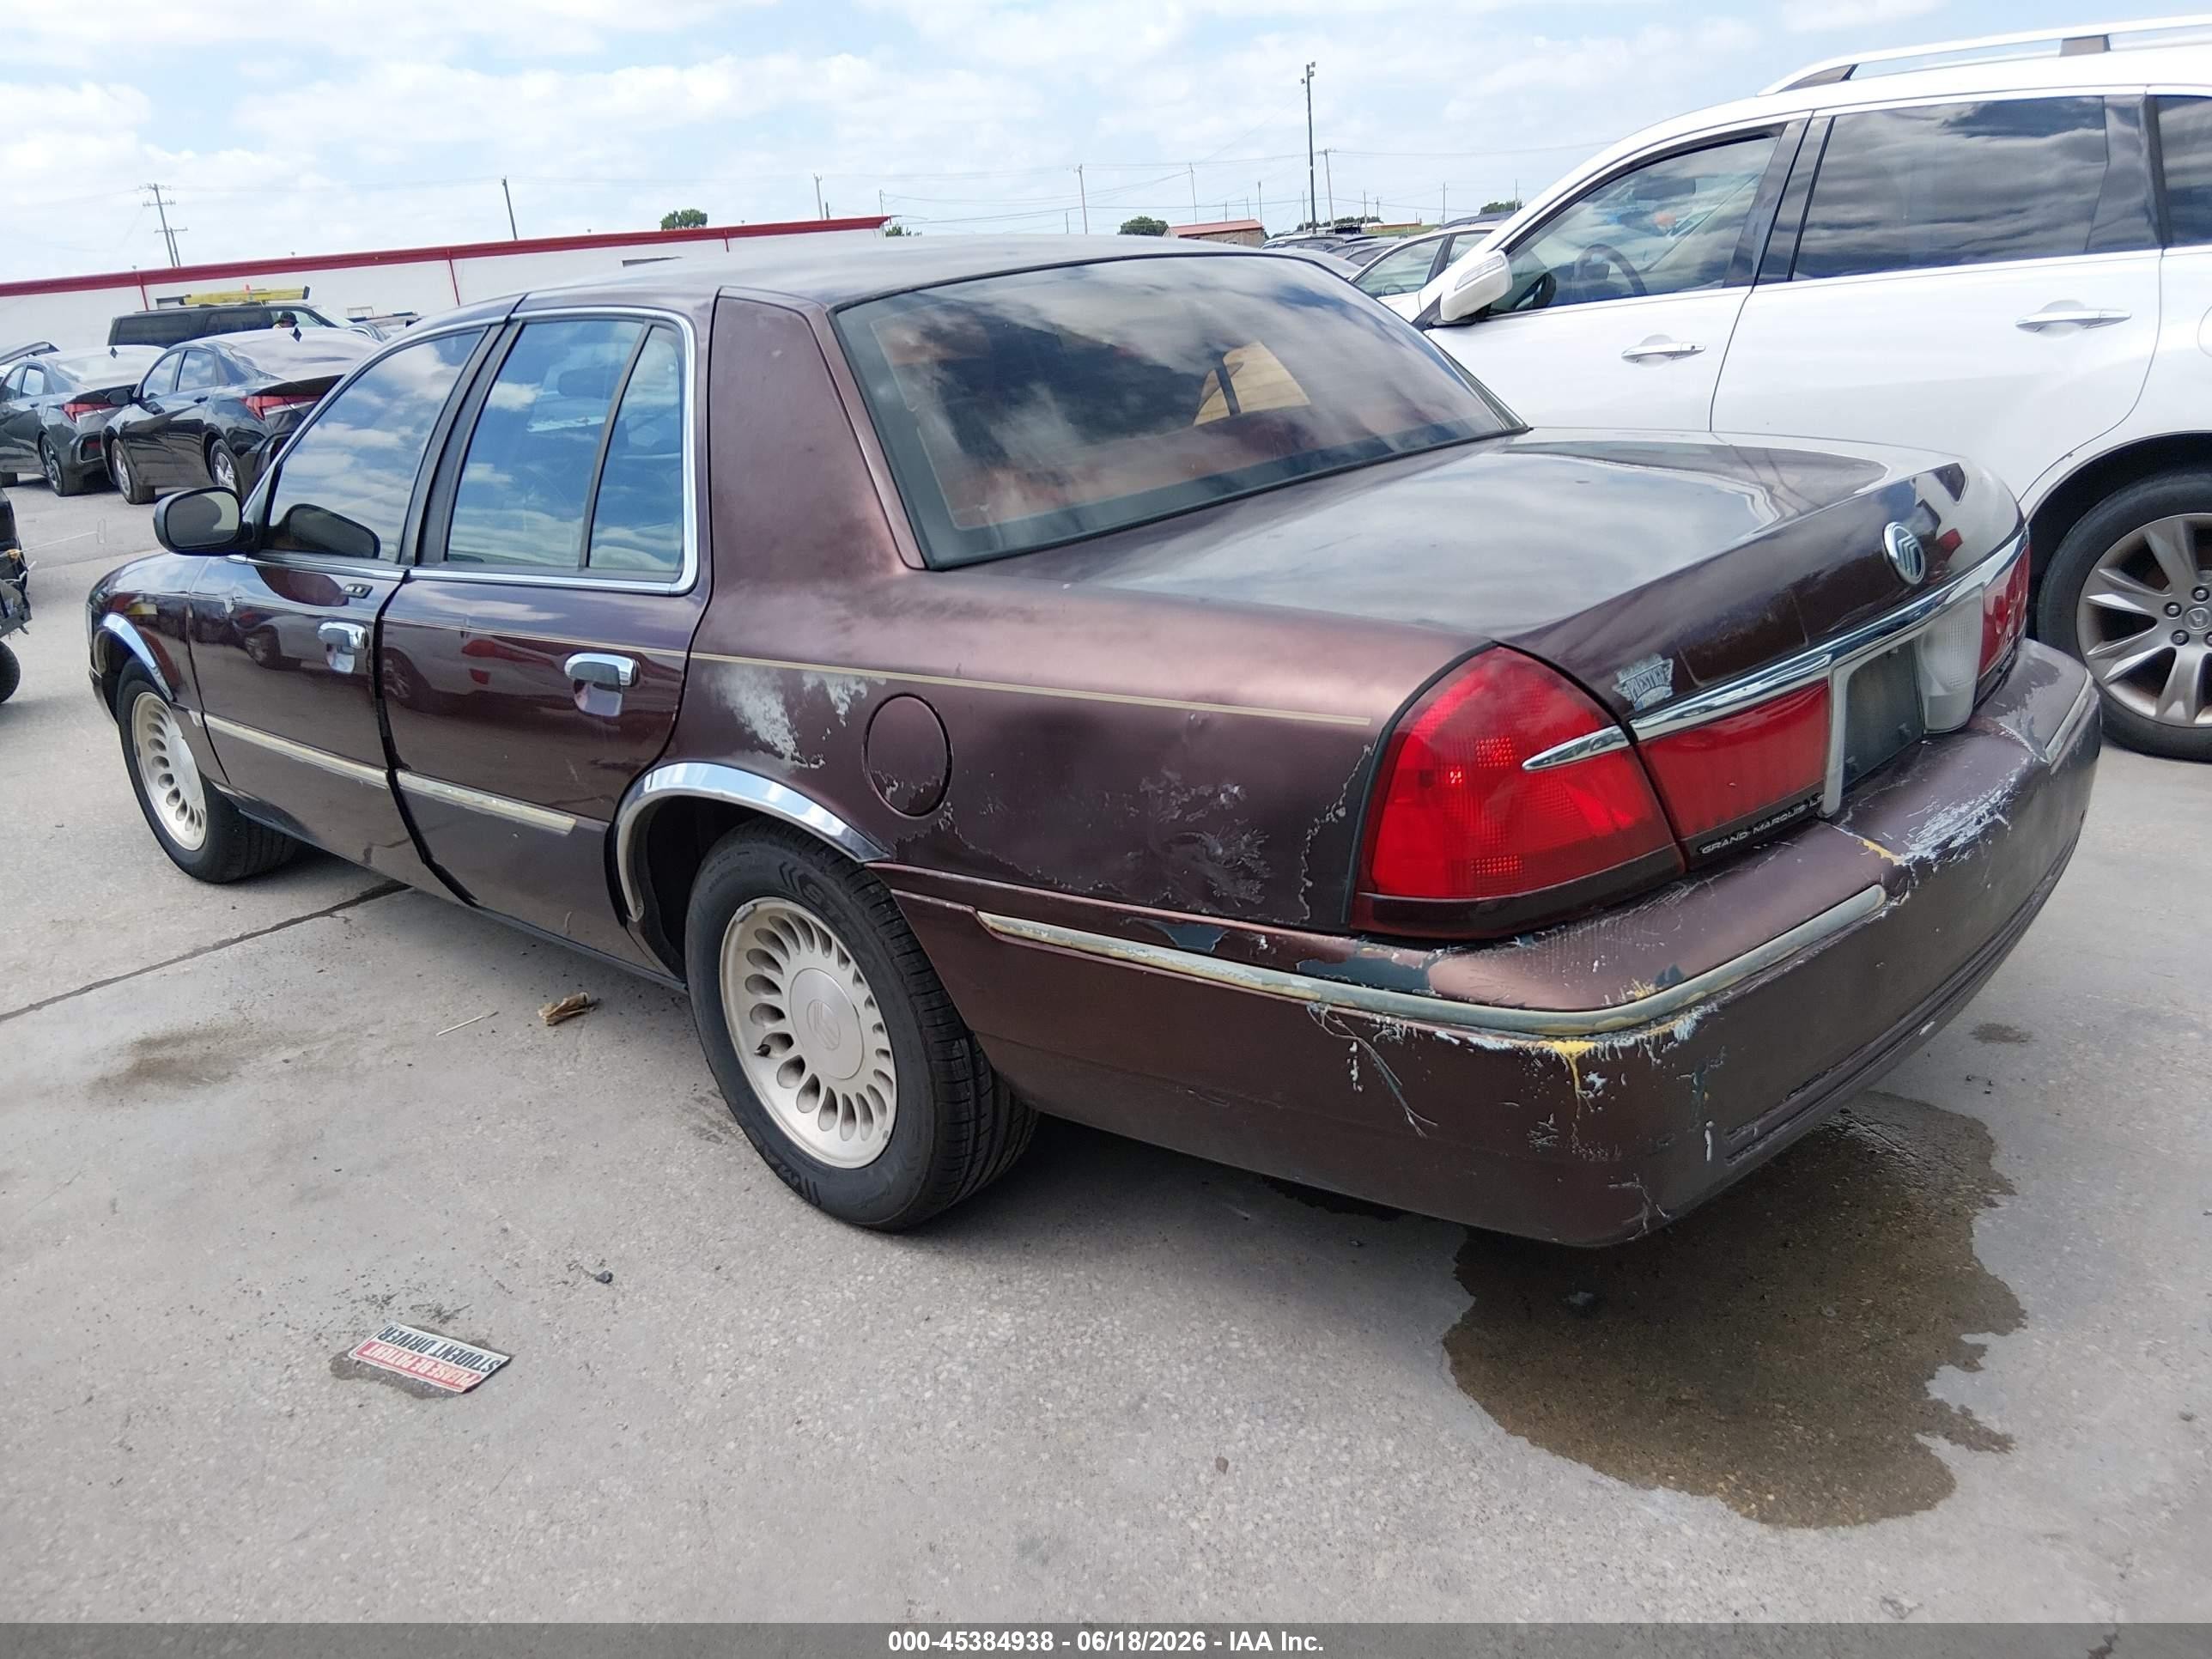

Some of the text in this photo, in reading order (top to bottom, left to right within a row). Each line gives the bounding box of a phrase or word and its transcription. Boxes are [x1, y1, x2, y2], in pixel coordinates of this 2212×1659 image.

[1701, 830, 1749, 854] GRAND
[1753, 804, 1808, 835] MARQUIS
[362, 1344, 477, 1387] PLEASE BE PATIENT
[377, 1325, 501, 1373] STUDENT DRIVER
